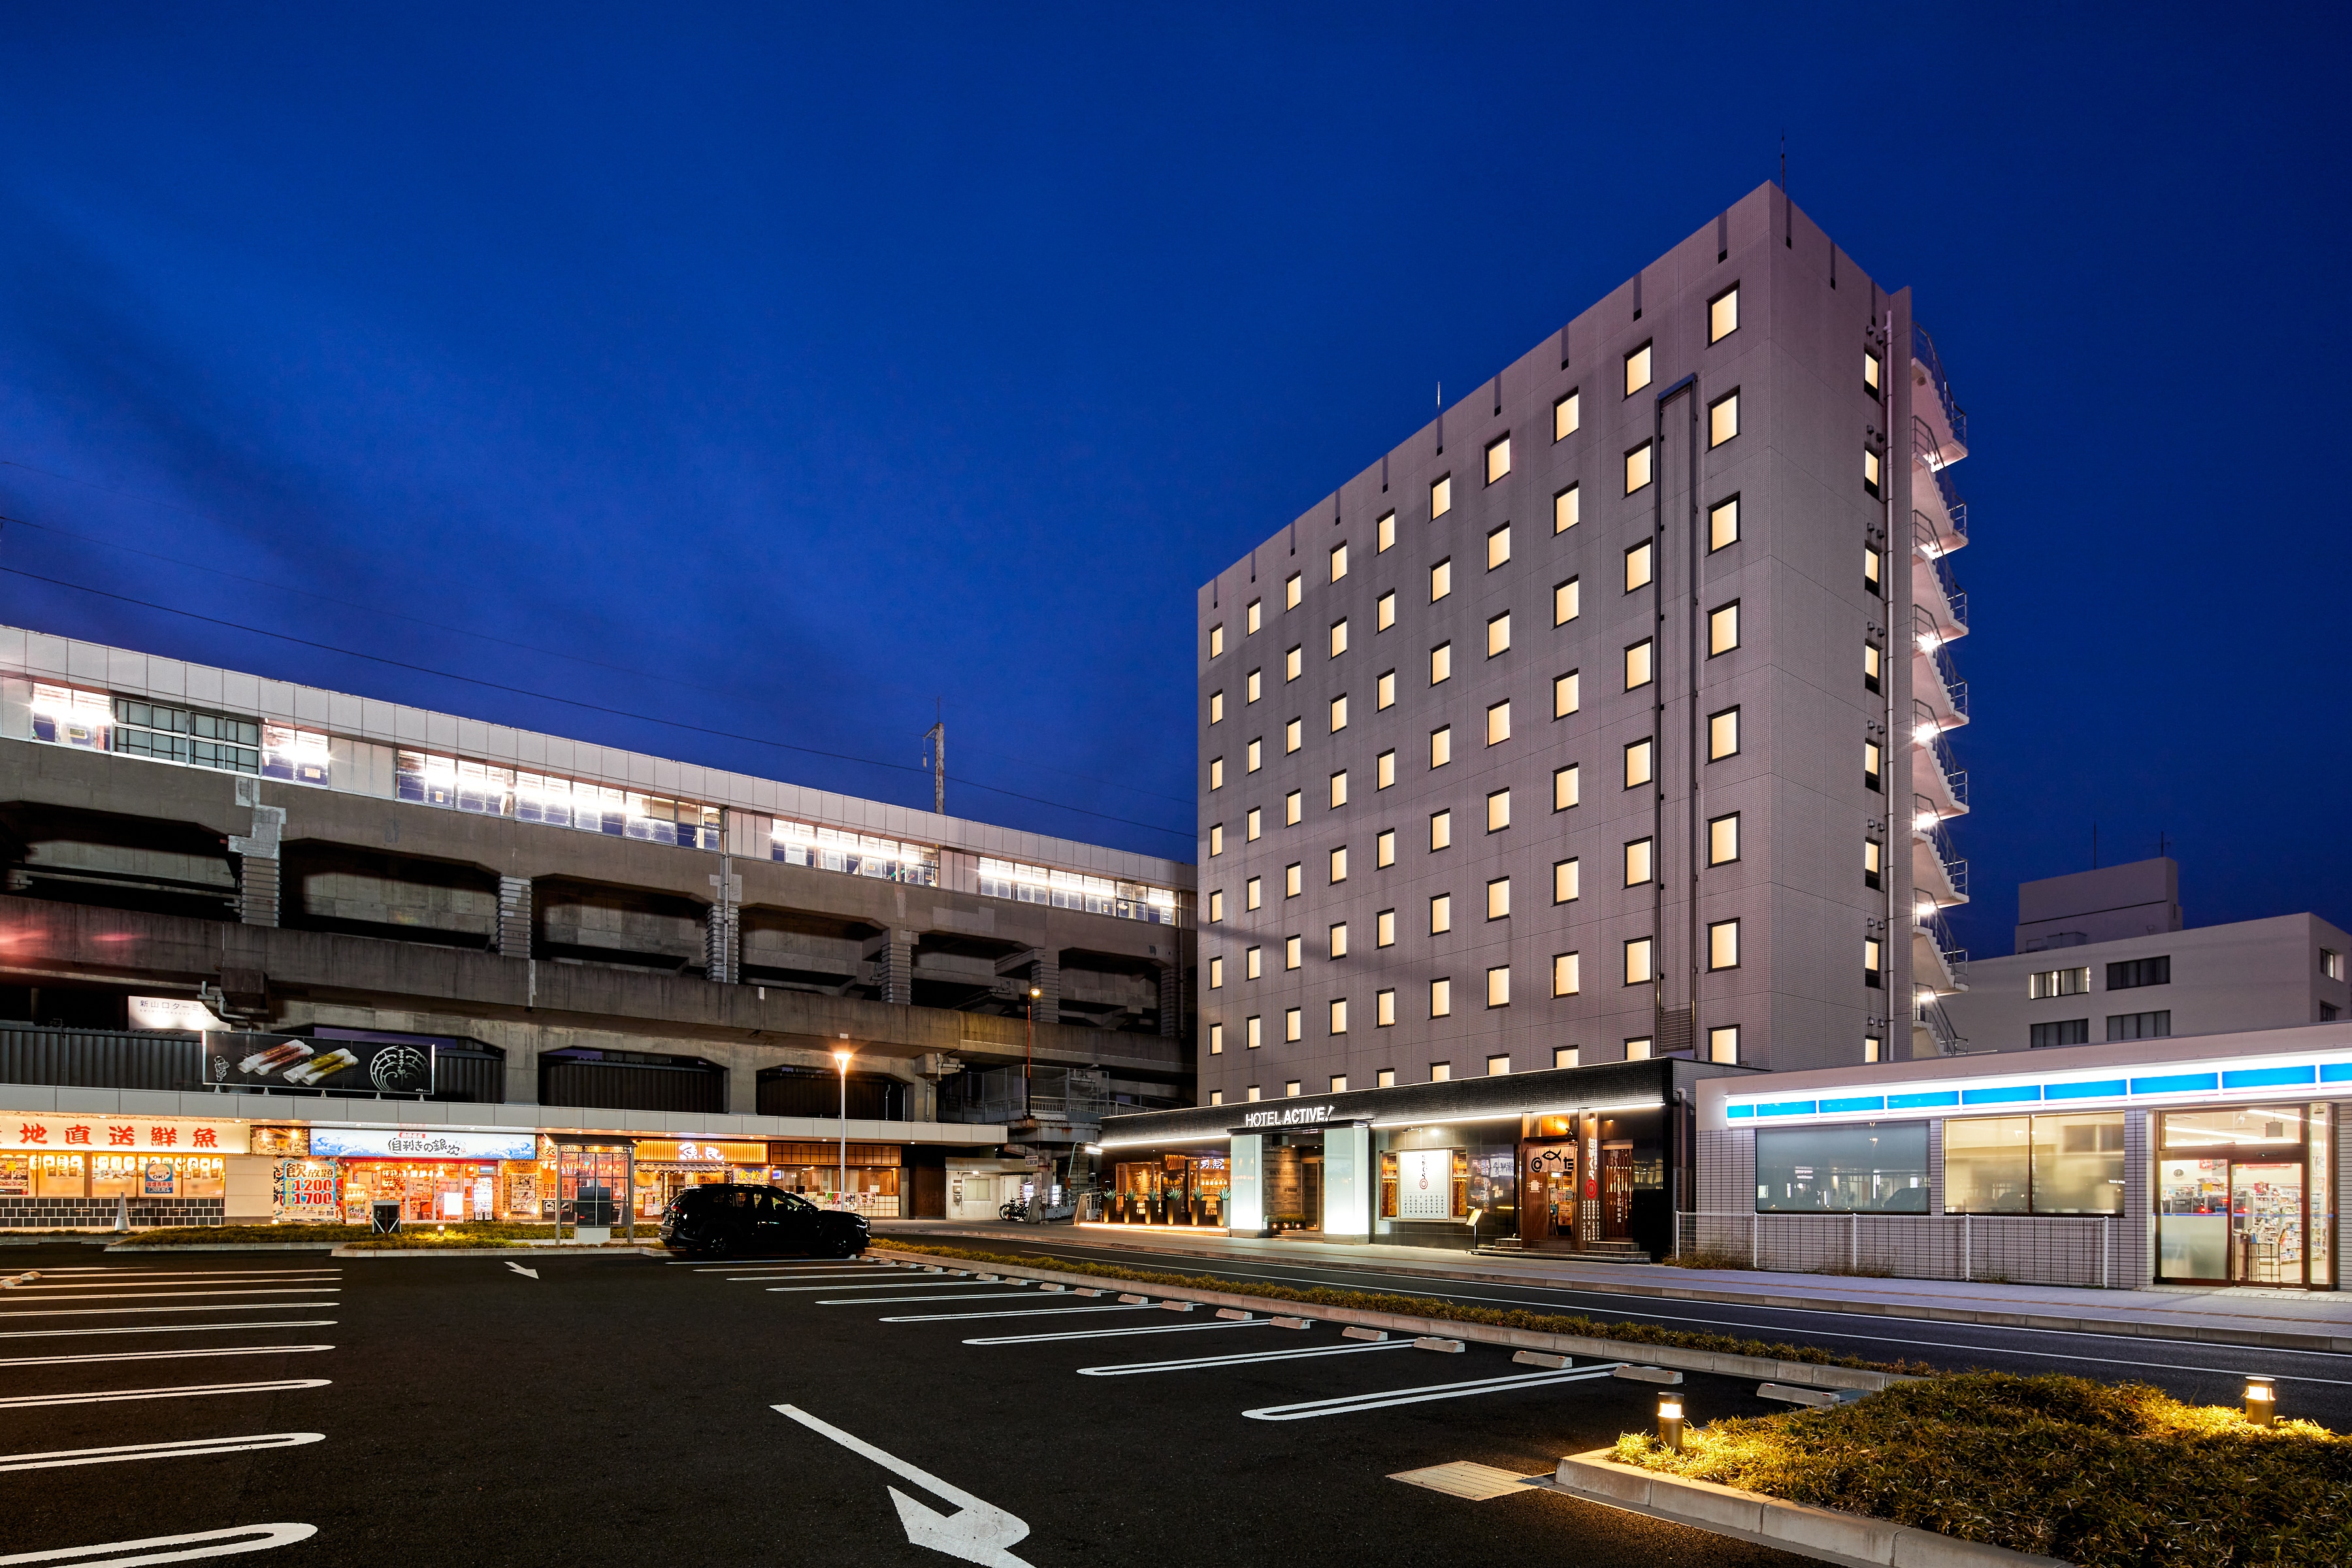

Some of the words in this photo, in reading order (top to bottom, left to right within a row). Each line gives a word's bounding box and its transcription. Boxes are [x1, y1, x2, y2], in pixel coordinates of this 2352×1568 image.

[1245, 1111, 1281, 1127] HOTEL
[1283, 1105, 1335, 1124] ACTIVE!
[0, 1123, 218, 1149] 地直送鮮魚
[678, 1142, 725, 1161] 魚民
